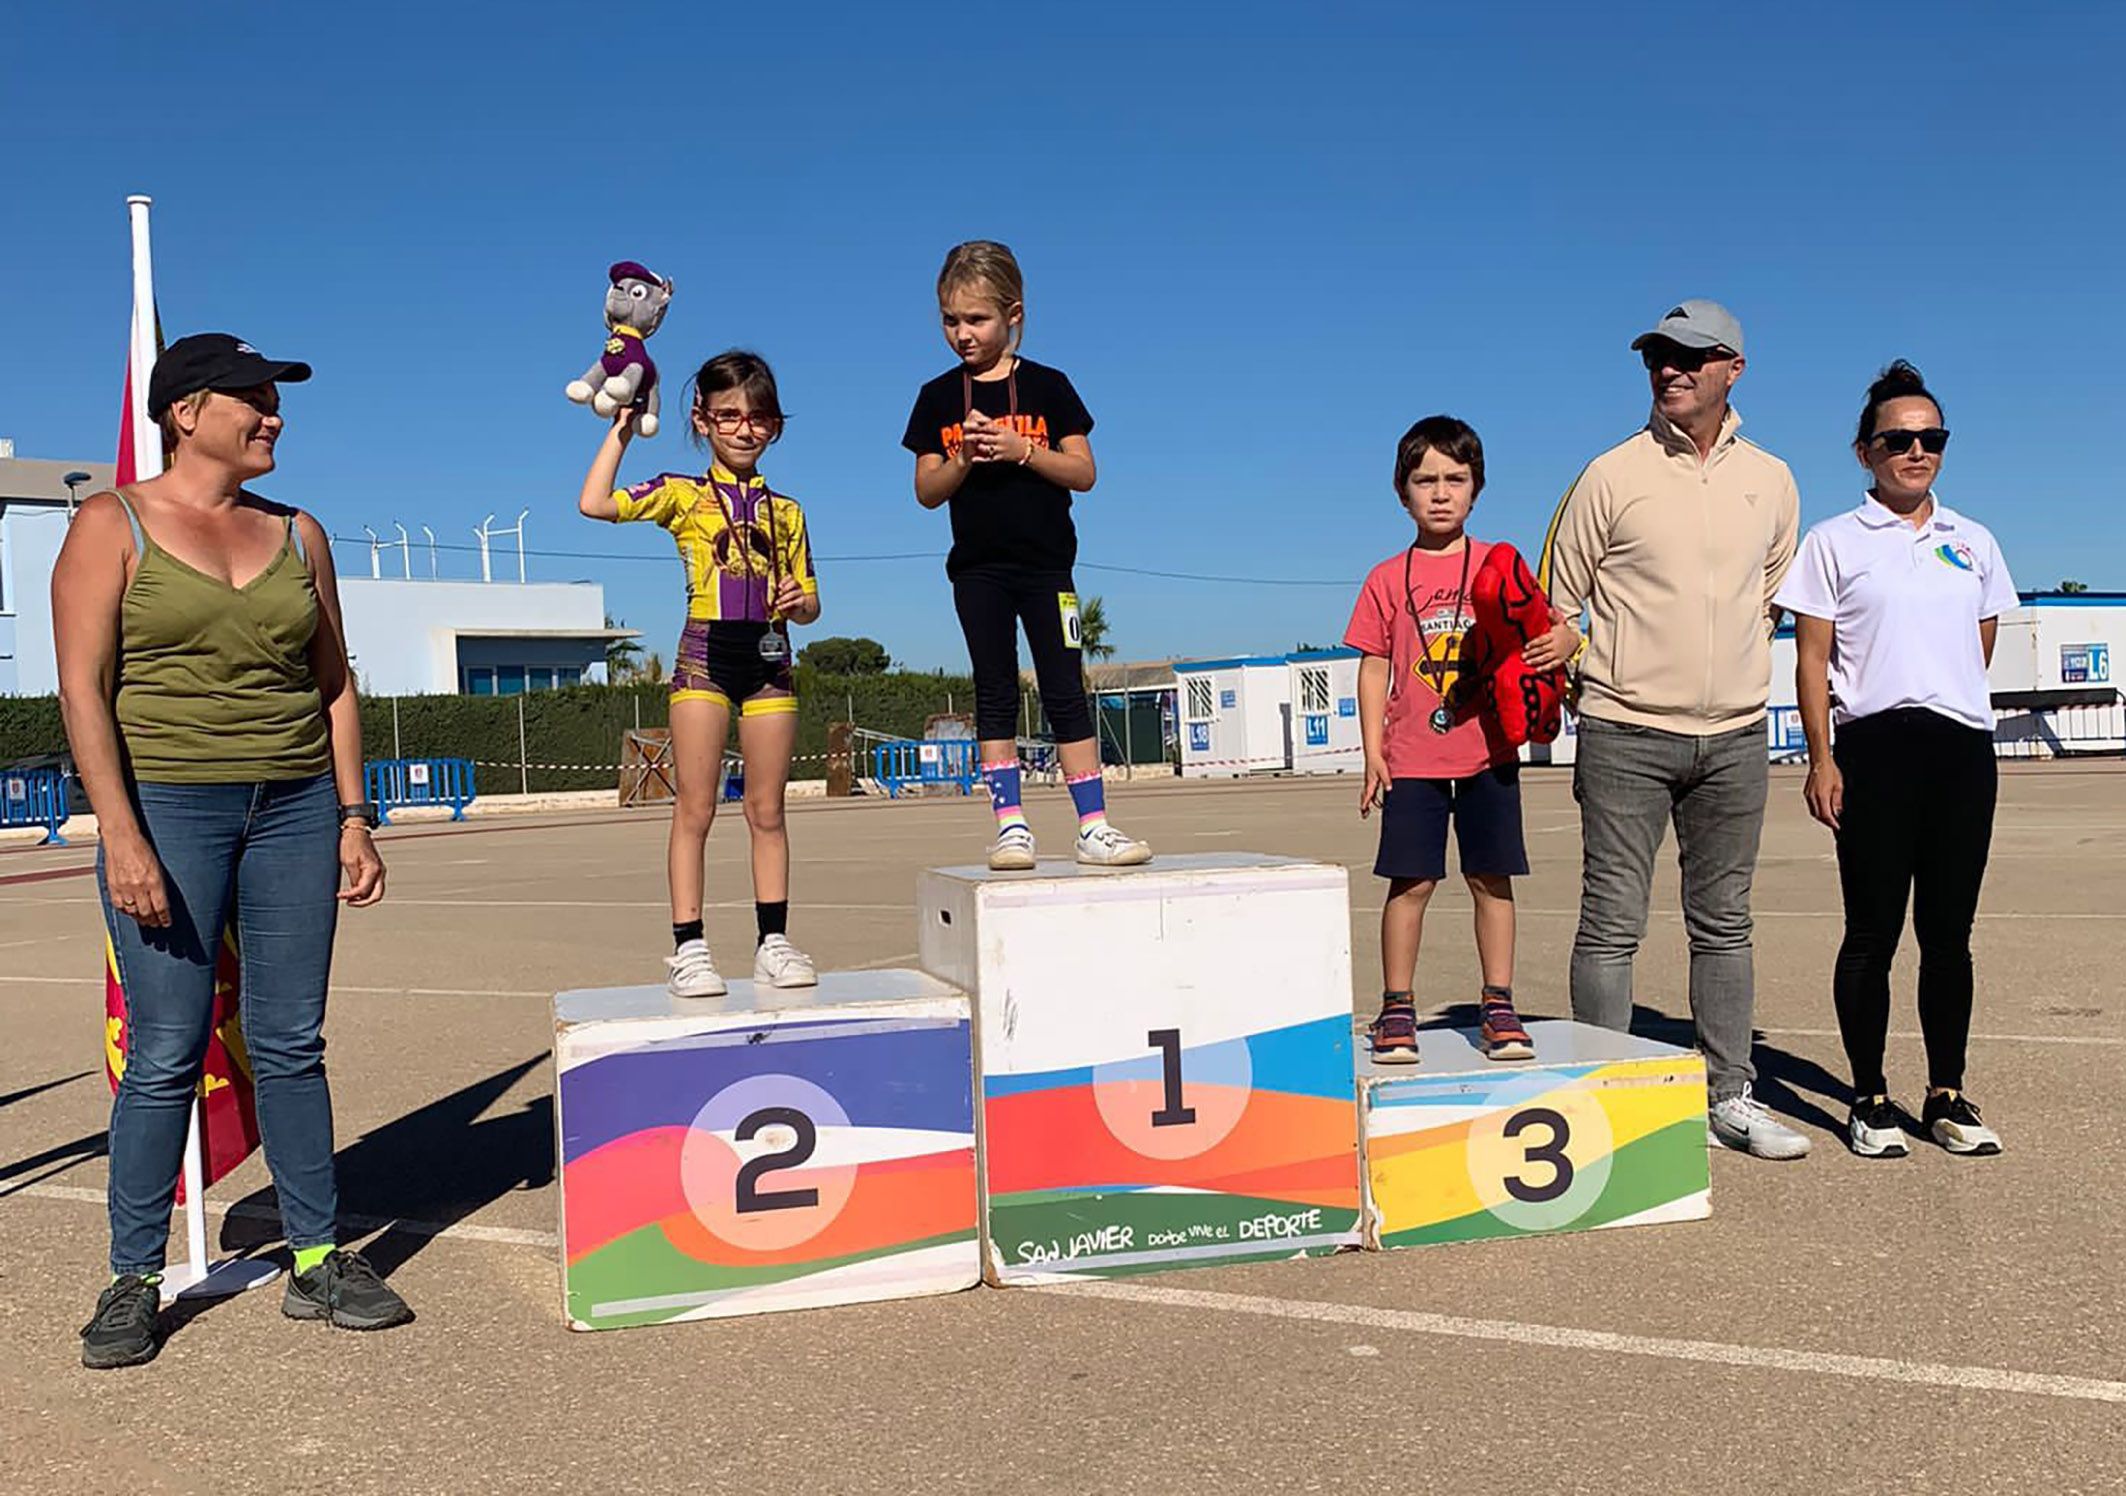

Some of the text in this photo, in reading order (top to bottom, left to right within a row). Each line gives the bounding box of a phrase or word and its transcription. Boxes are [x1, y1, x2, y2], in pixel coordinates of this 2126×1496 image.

[2089, 651, 2108, 680] L6
[1308, 717, 1325, 736] L11
[1149, 1029, 1196, 1127] 1
[735, 1108, 818, 1213] 2
[1503, 1108, 1574, 1203] 3
[1062, 1225, 1134, 1261] JAVIER
[1239, 1208, 1323, 1239] DEPORTE
